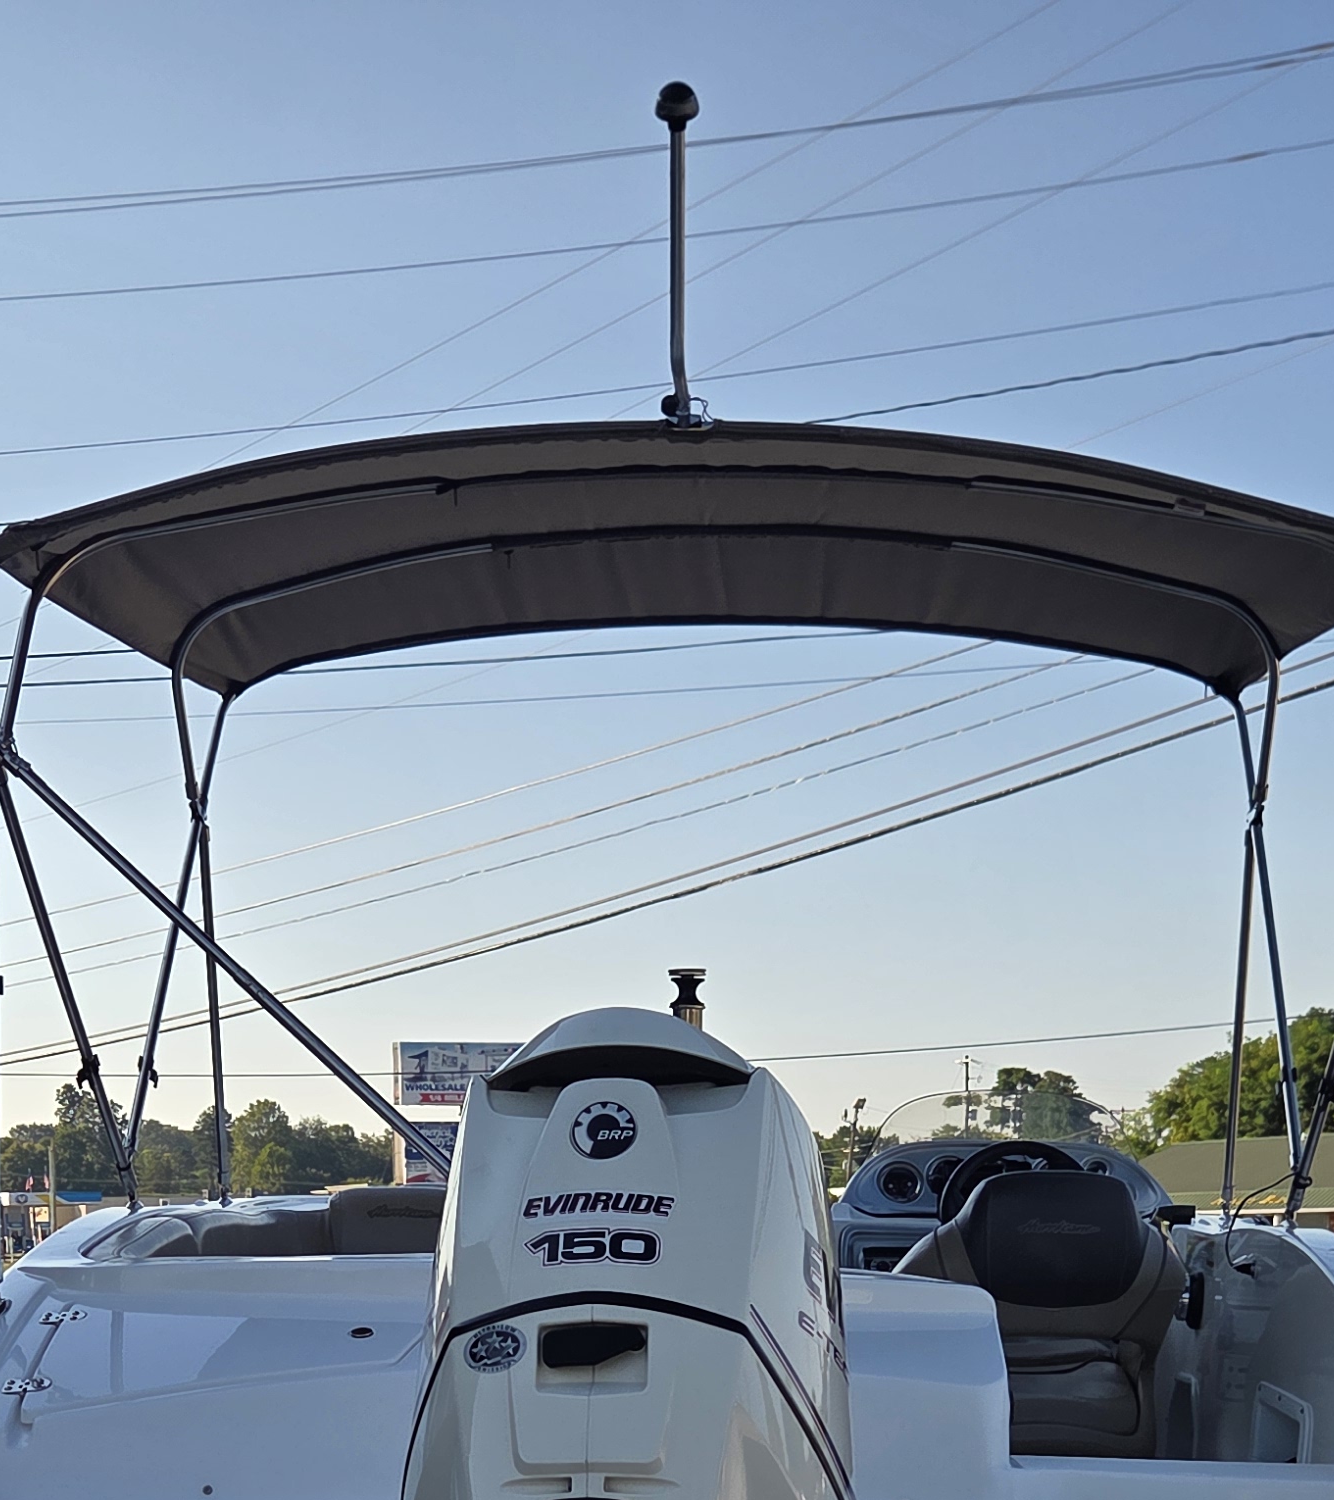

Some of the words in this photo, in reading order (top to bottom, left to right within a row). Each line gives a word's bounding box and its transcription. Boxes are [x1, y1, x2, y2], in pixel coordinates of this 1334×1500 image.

[405, 1083, 466, 1092] WHOLESALE
[597, 1130, 634, 1140] BRP
[523, 1192, 675, 1219] EVINRUDE
[524, 1227, 662, 1267] 150
